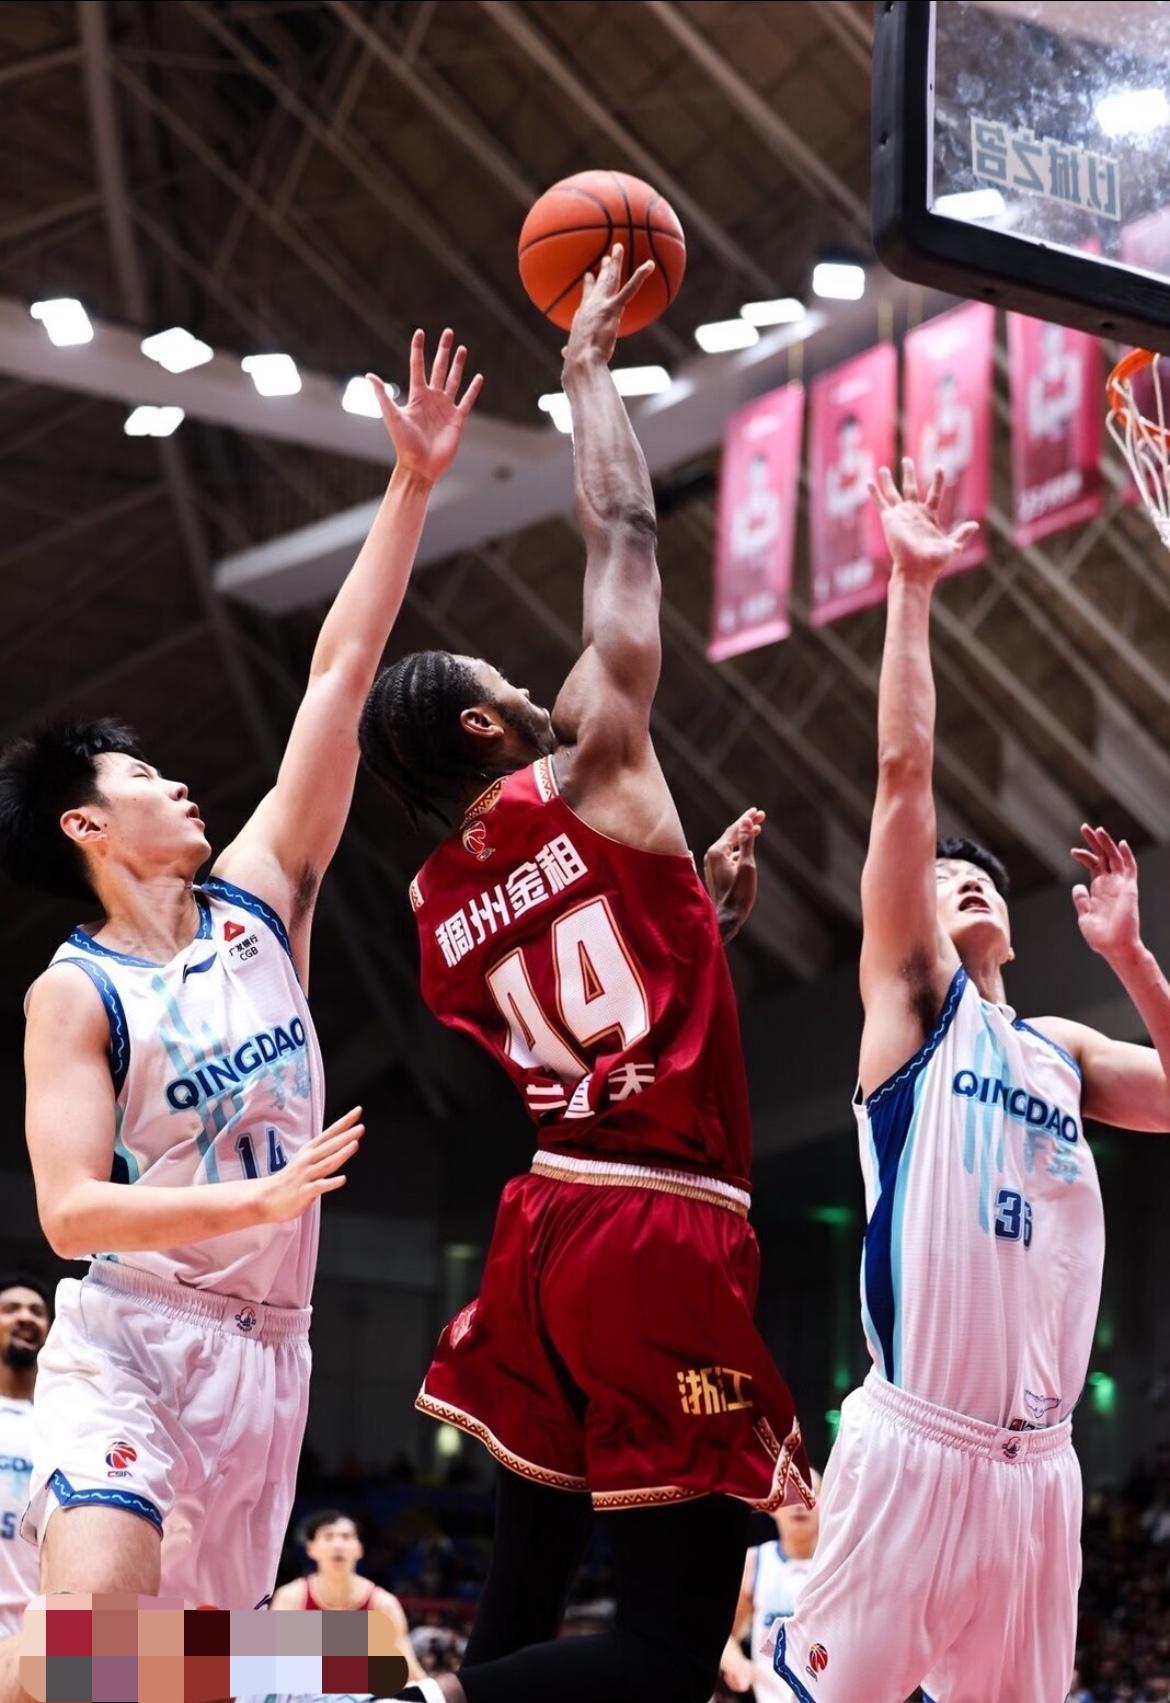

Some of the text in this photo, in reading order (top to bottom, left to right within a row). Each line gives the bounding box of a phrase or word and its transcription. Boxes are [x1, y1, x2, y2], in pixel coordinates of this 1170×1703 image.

[434, 832, 589, 968] 稠州金租
[240, 946, 259, 961] CGB
[485, 895, 650, 1080] 44
[165, 1016, 307, 1110] QINGDAO
[952, 1069, 1079, 1143] QINGDAO
[235, 1127, 288, 1180] 14
[677, 1366, 753, 1415] 浙江
